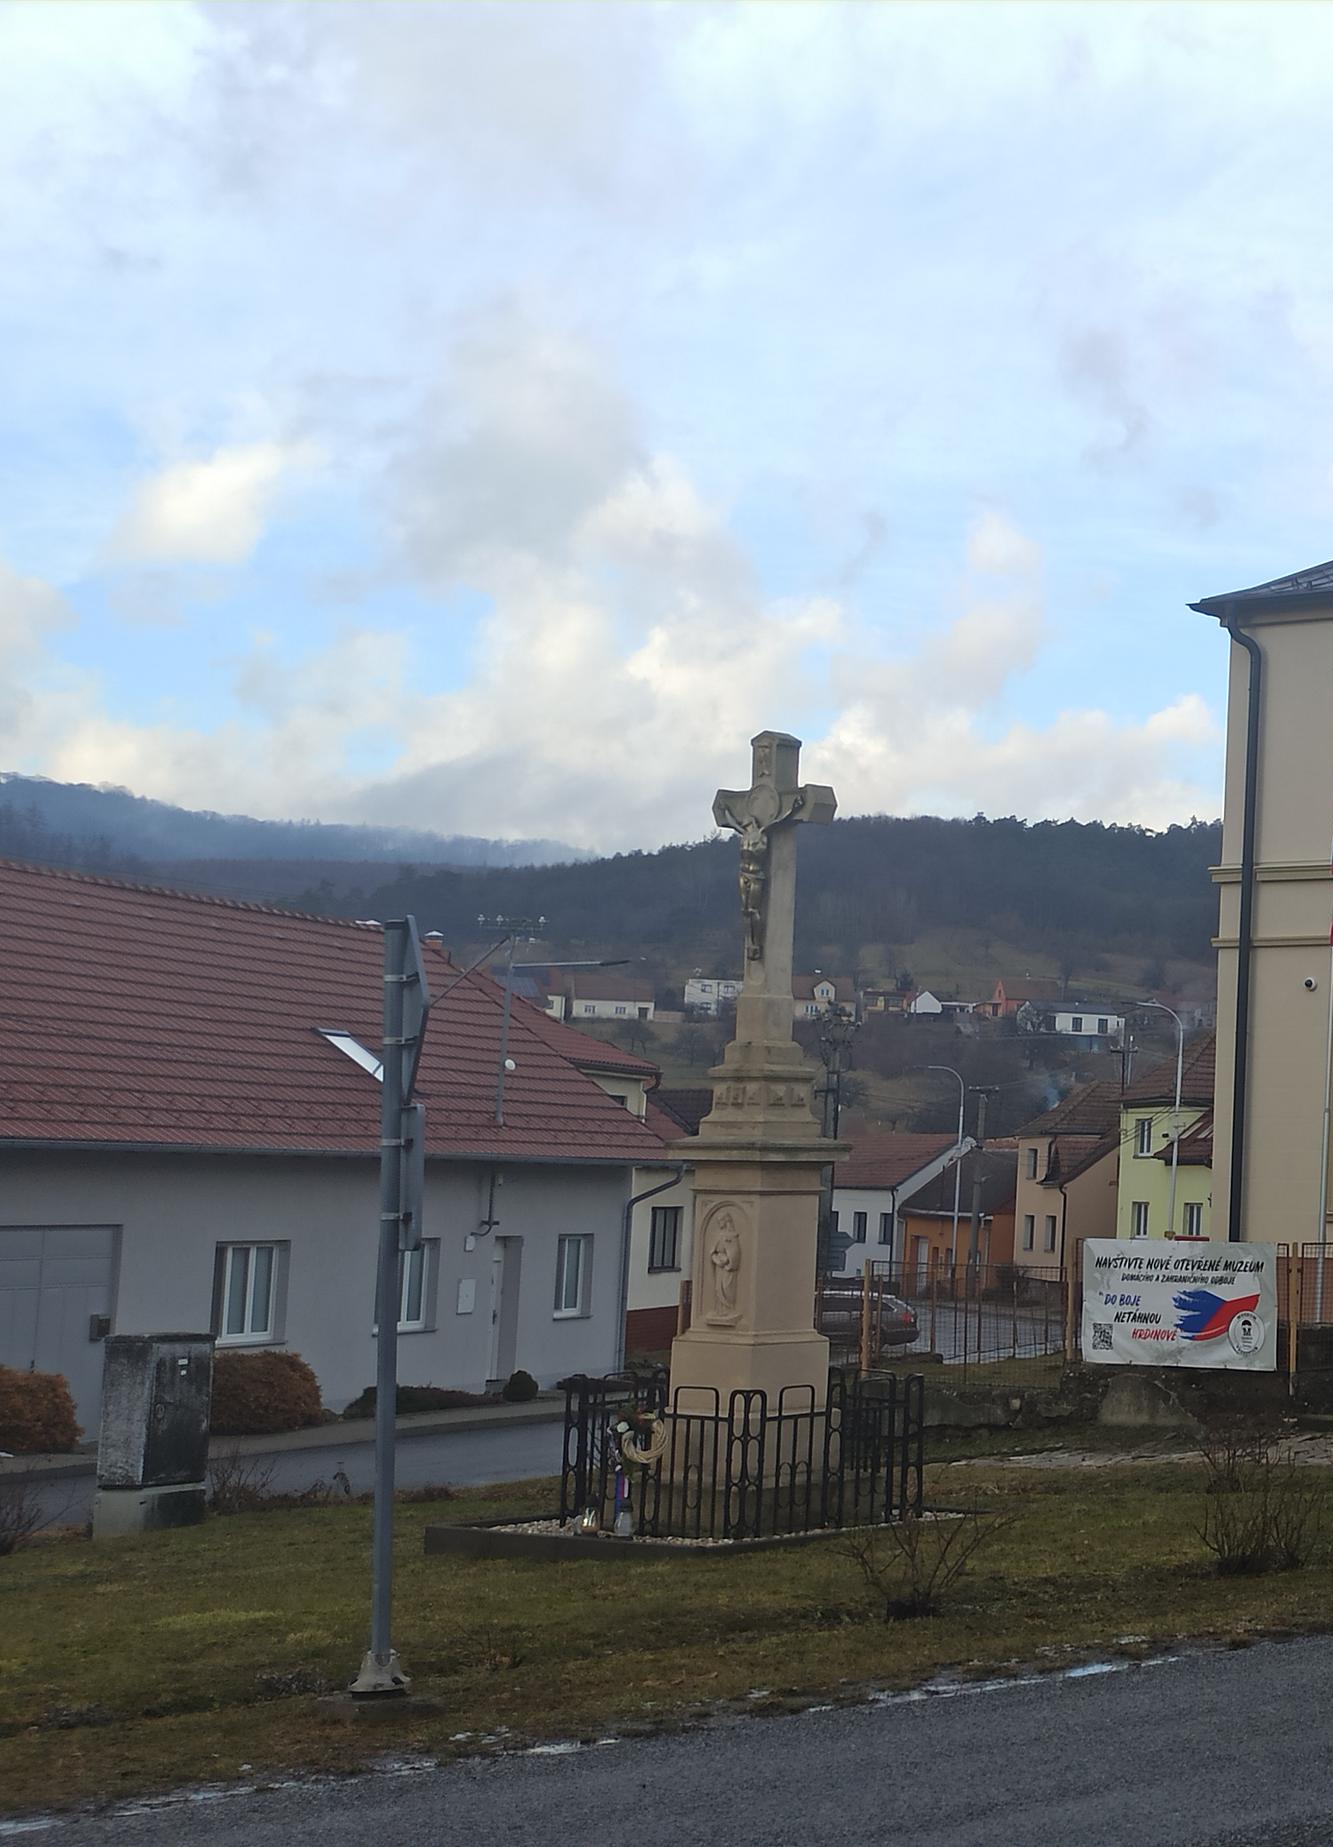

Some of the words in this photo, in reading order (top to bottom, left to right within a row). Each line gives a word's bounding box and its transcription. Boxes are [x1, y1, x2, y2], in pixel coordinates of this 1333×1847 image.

[1095, 1253, 1145, 1269] NAVŠTIVTE
[1146, 1255, 1173, 1271] NOVÉ
[1173, 1256, 1222, 1272] OTEVŘENÉ
[1223, 1259, 1264, 1273] MUZEUM
[1119, 1293, 1141, 1306] BOJE
[1114, 1308, 1161, 1325] NETÁHNOU
